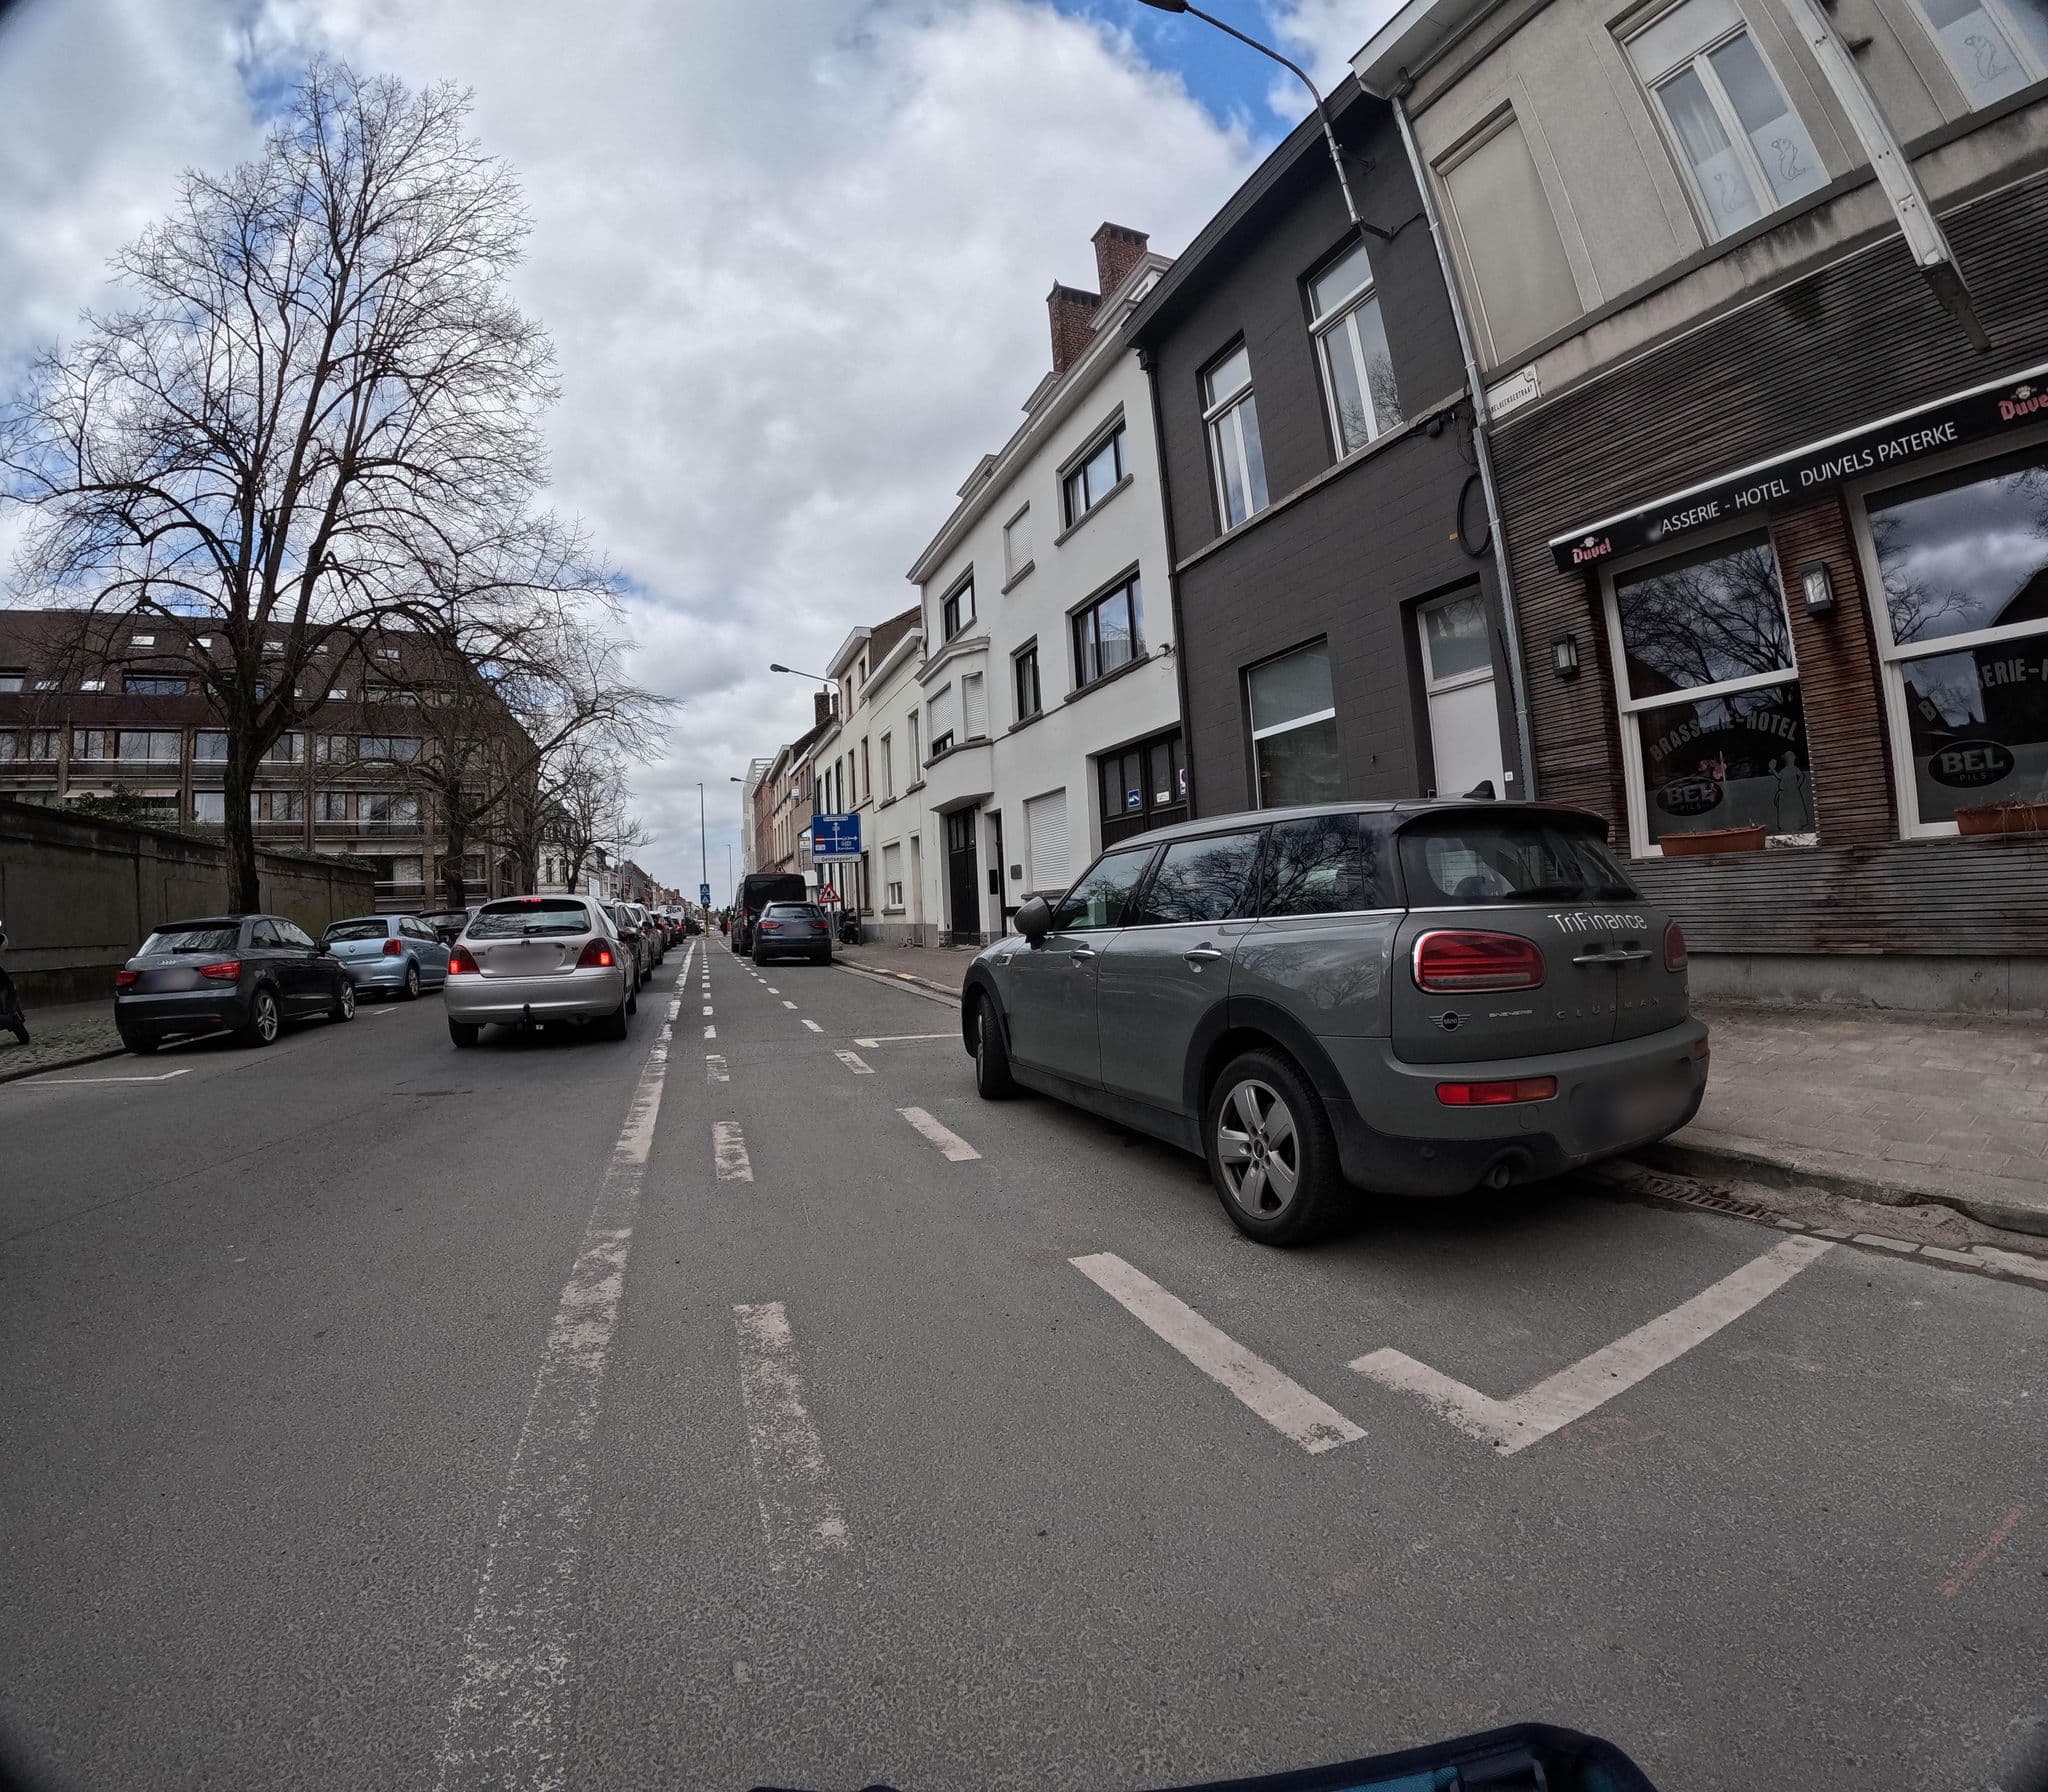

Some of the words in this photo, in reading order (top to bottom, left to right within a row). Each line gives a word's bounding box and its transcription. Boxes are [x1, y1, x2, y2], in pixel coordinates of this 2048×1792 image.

[1998, 388, 2048, 421] Duve
[1661, 500, 1721, 535] ASSERIE
[1735, 478, 1791, 509] HOTEL
[1800, 449, 1874, 487] DUIVELS
[1877, 422, 1958, 462] PATERKE
[1572, 538, 1612, 564] Duvel
[1939, 747, 2004, 774] BEL
[1959, 773, 1987, 782] PILS
[1548, 912, 1648, 934] TriFinance
